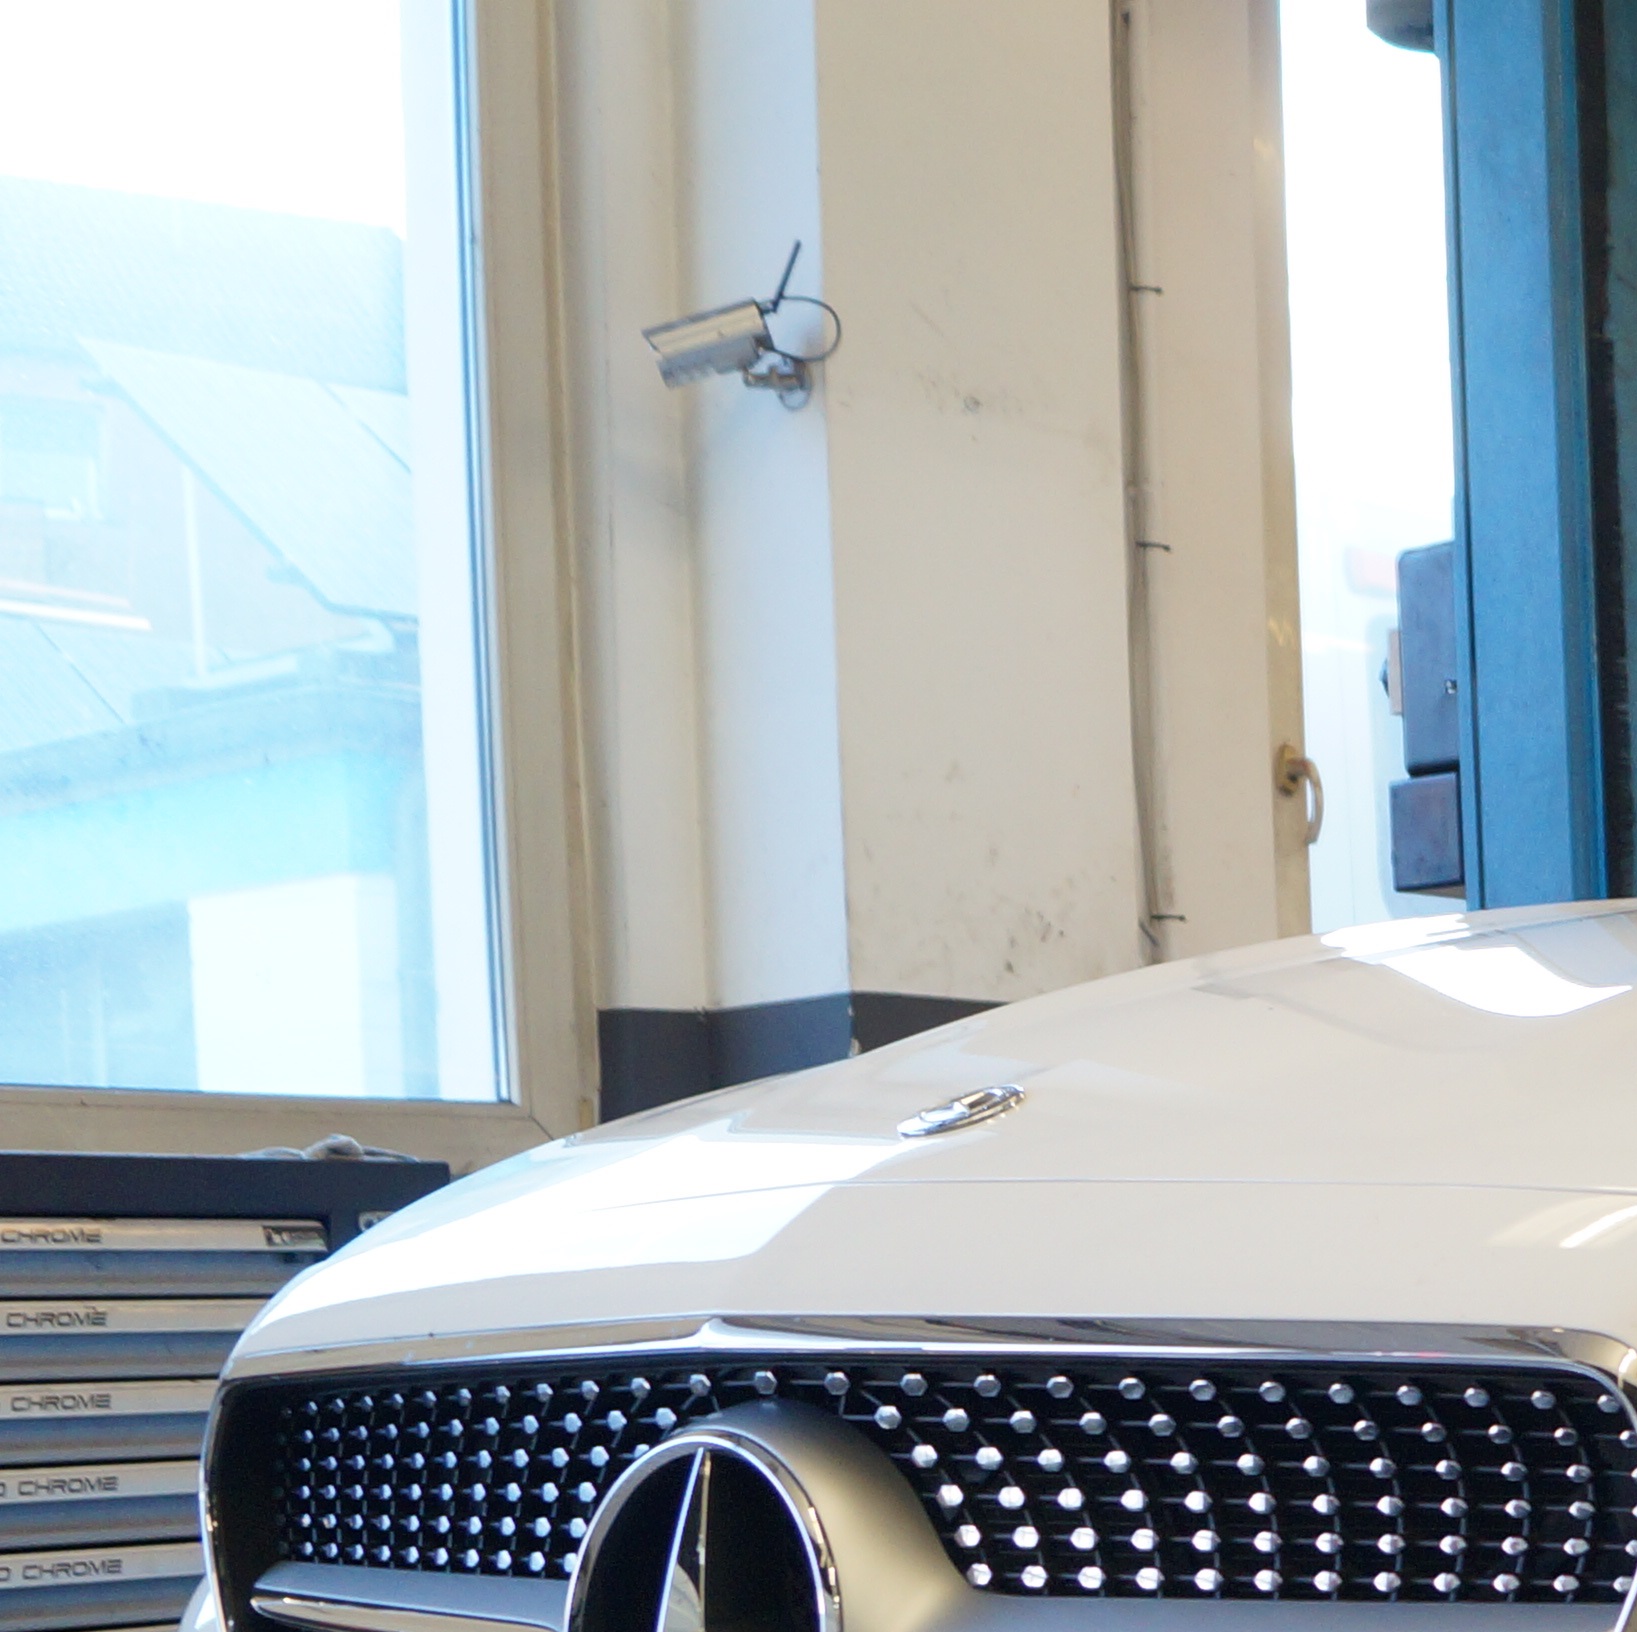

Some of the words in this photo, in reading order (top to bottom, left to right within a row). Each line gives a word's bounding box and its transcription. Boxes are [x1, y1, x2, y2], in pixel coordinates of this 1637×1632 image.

[1, 1228, 103, 1244] CHROME
[6, 1310, 108, 1328] CHROME
[11, 1393, 112, 1412] CHROME
[18, 1476, 119, 1497] CHROME
[22, 1558, 123, 1581] CHROME
